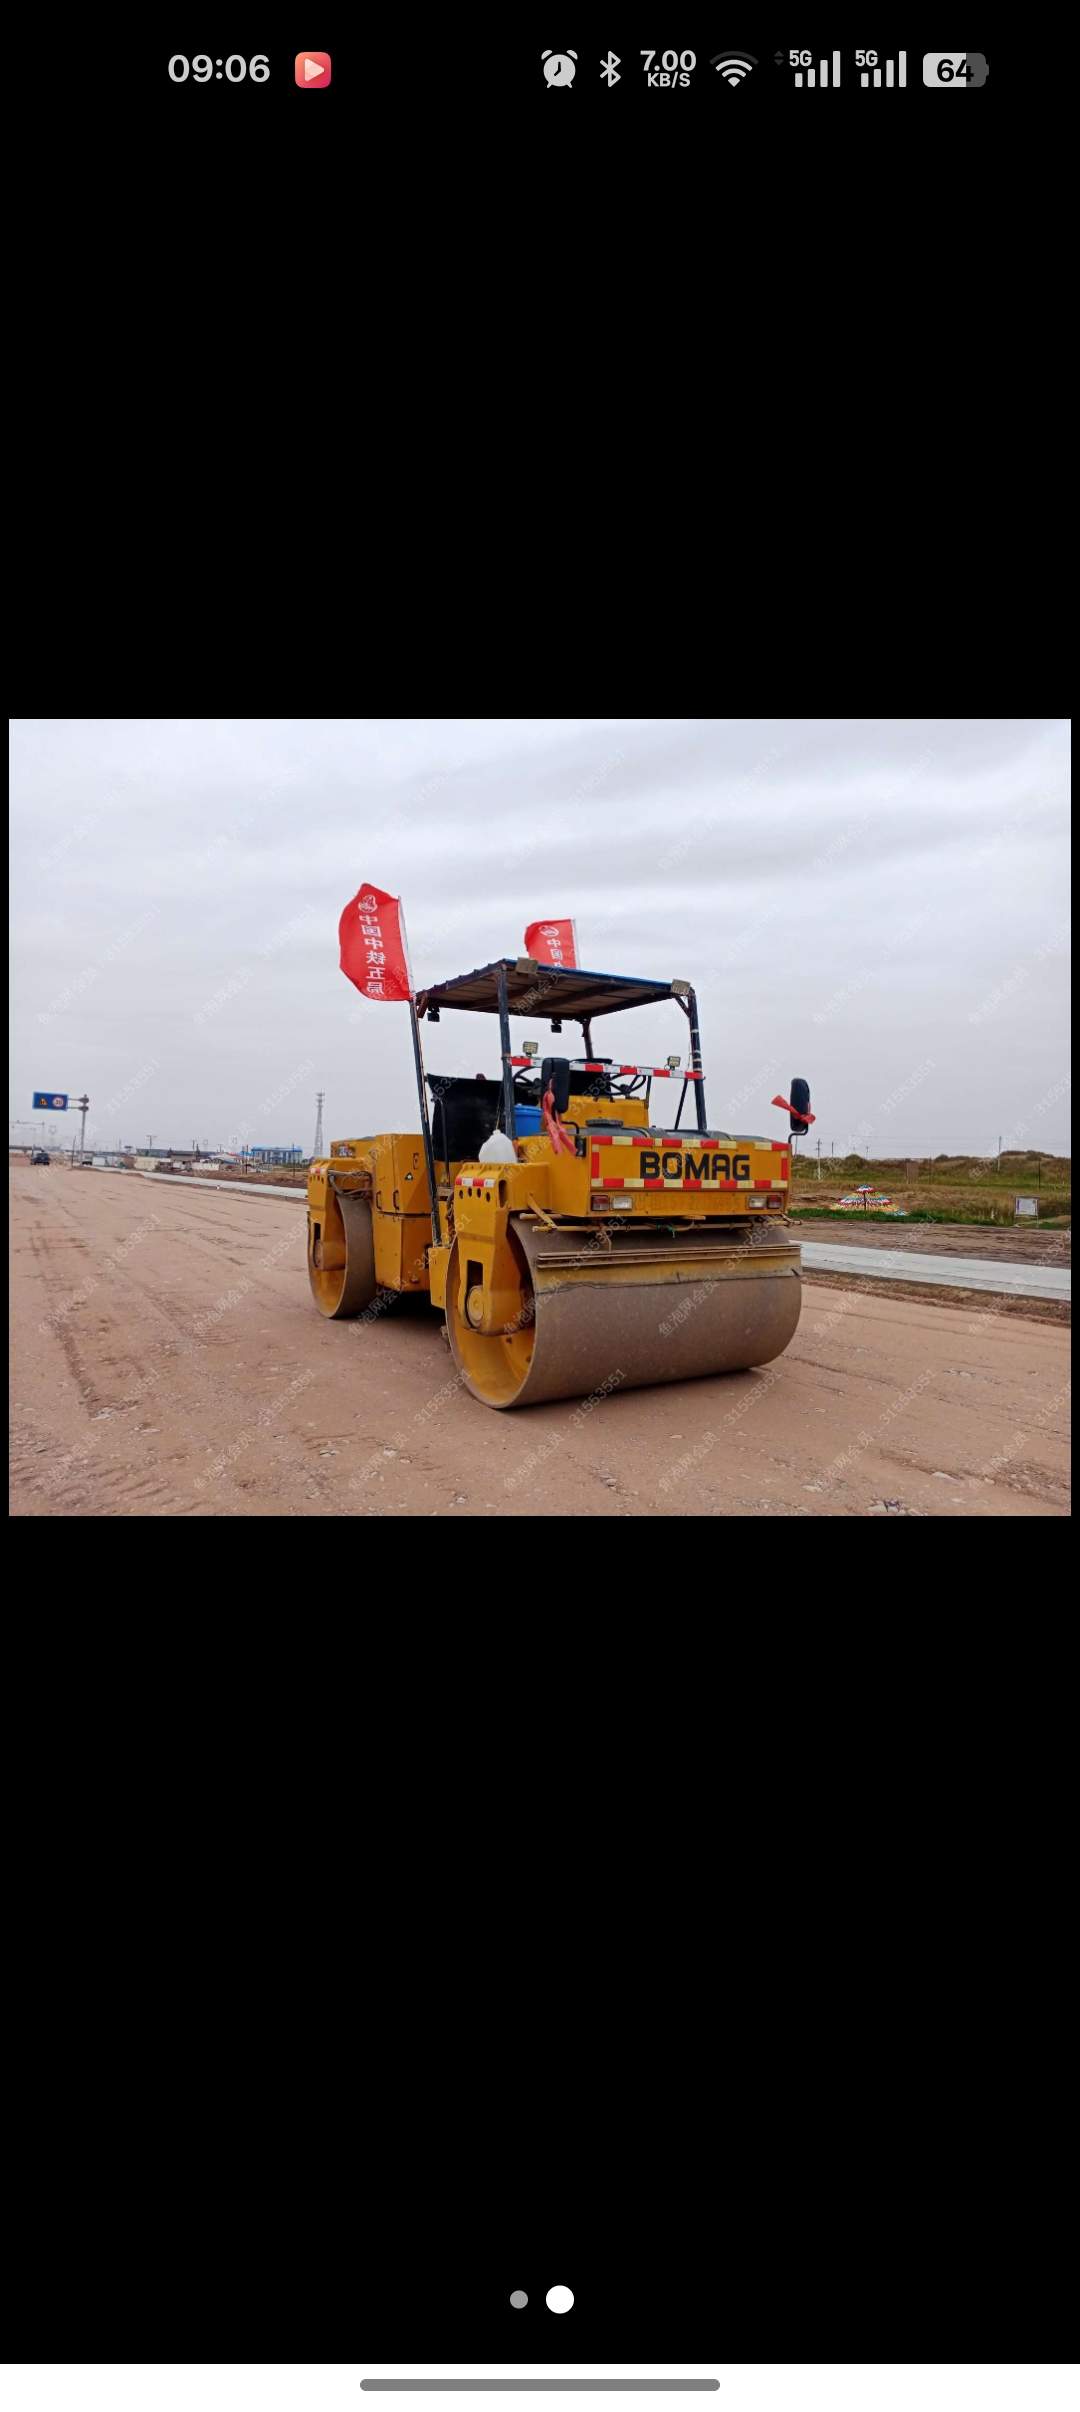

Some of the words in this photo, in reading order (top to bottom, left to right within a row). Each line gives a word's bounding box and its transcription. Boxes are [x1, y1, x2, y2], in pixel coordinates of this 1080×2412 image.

[168, 54, 271, 83] 09:06
[641, 50, 696, 71] 7.00
[790, 50, 812, 67] 5G
[856, 50, 878, 67] 5G
[648, 72, 690, 88] KB/S
[937, 60, 975, 82] 64
[640, 1151, 751, 1181] BOMAG
